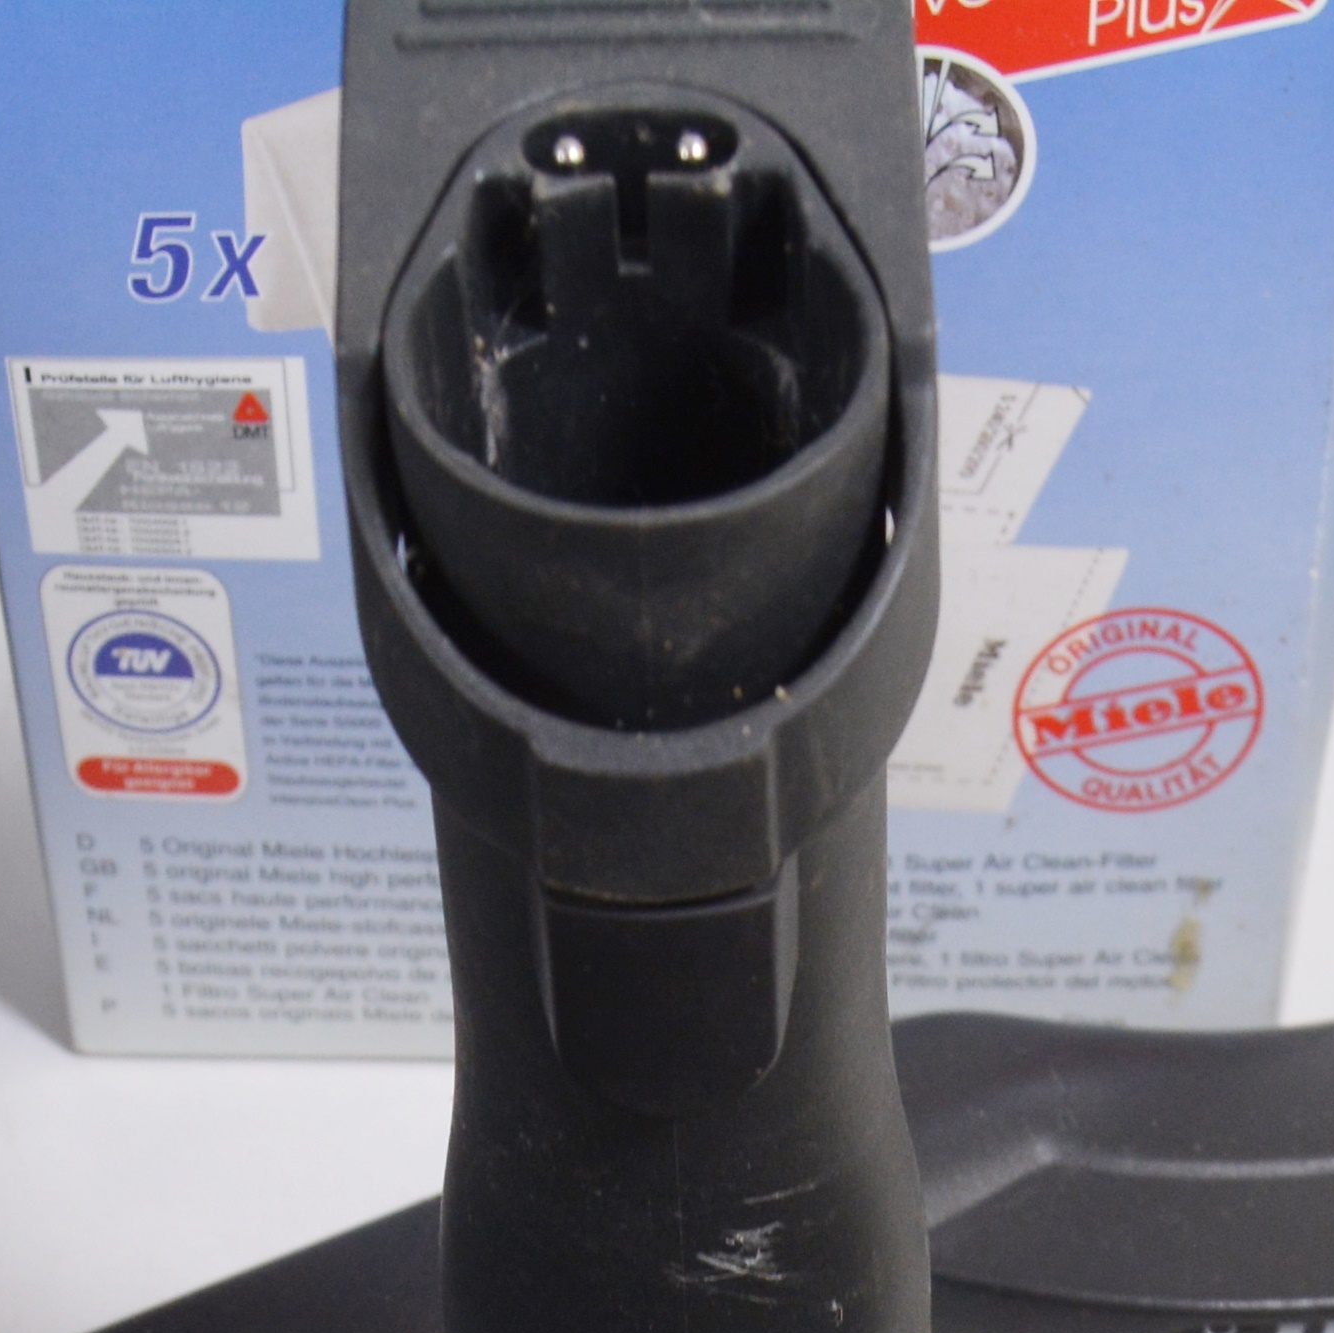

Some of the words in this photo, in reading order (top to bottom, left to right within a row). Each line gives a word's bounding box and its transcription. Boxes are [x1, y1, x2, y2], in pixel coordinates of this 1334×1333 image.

[150, 374, 254, 387] Lufthygiene
[233, 425, 269, 440] DMT
[1047, 618, 1199, 676] ORIGINAL
[1028, 683, 1247, 747] Miele
[1081, 752, 1223, 803] QUALITÄT
[76, 832, 94, 851] D
[163, 836, 254, 860] Original
[262, 841, 325, 861] Miele
[80, 857, 117, 878] GB
[167, 864, 251, 886] original
[259, 866, 321, 885] Miele
[905, 854, 972, 873] Super
[984, 854, 1015, 870] Air
